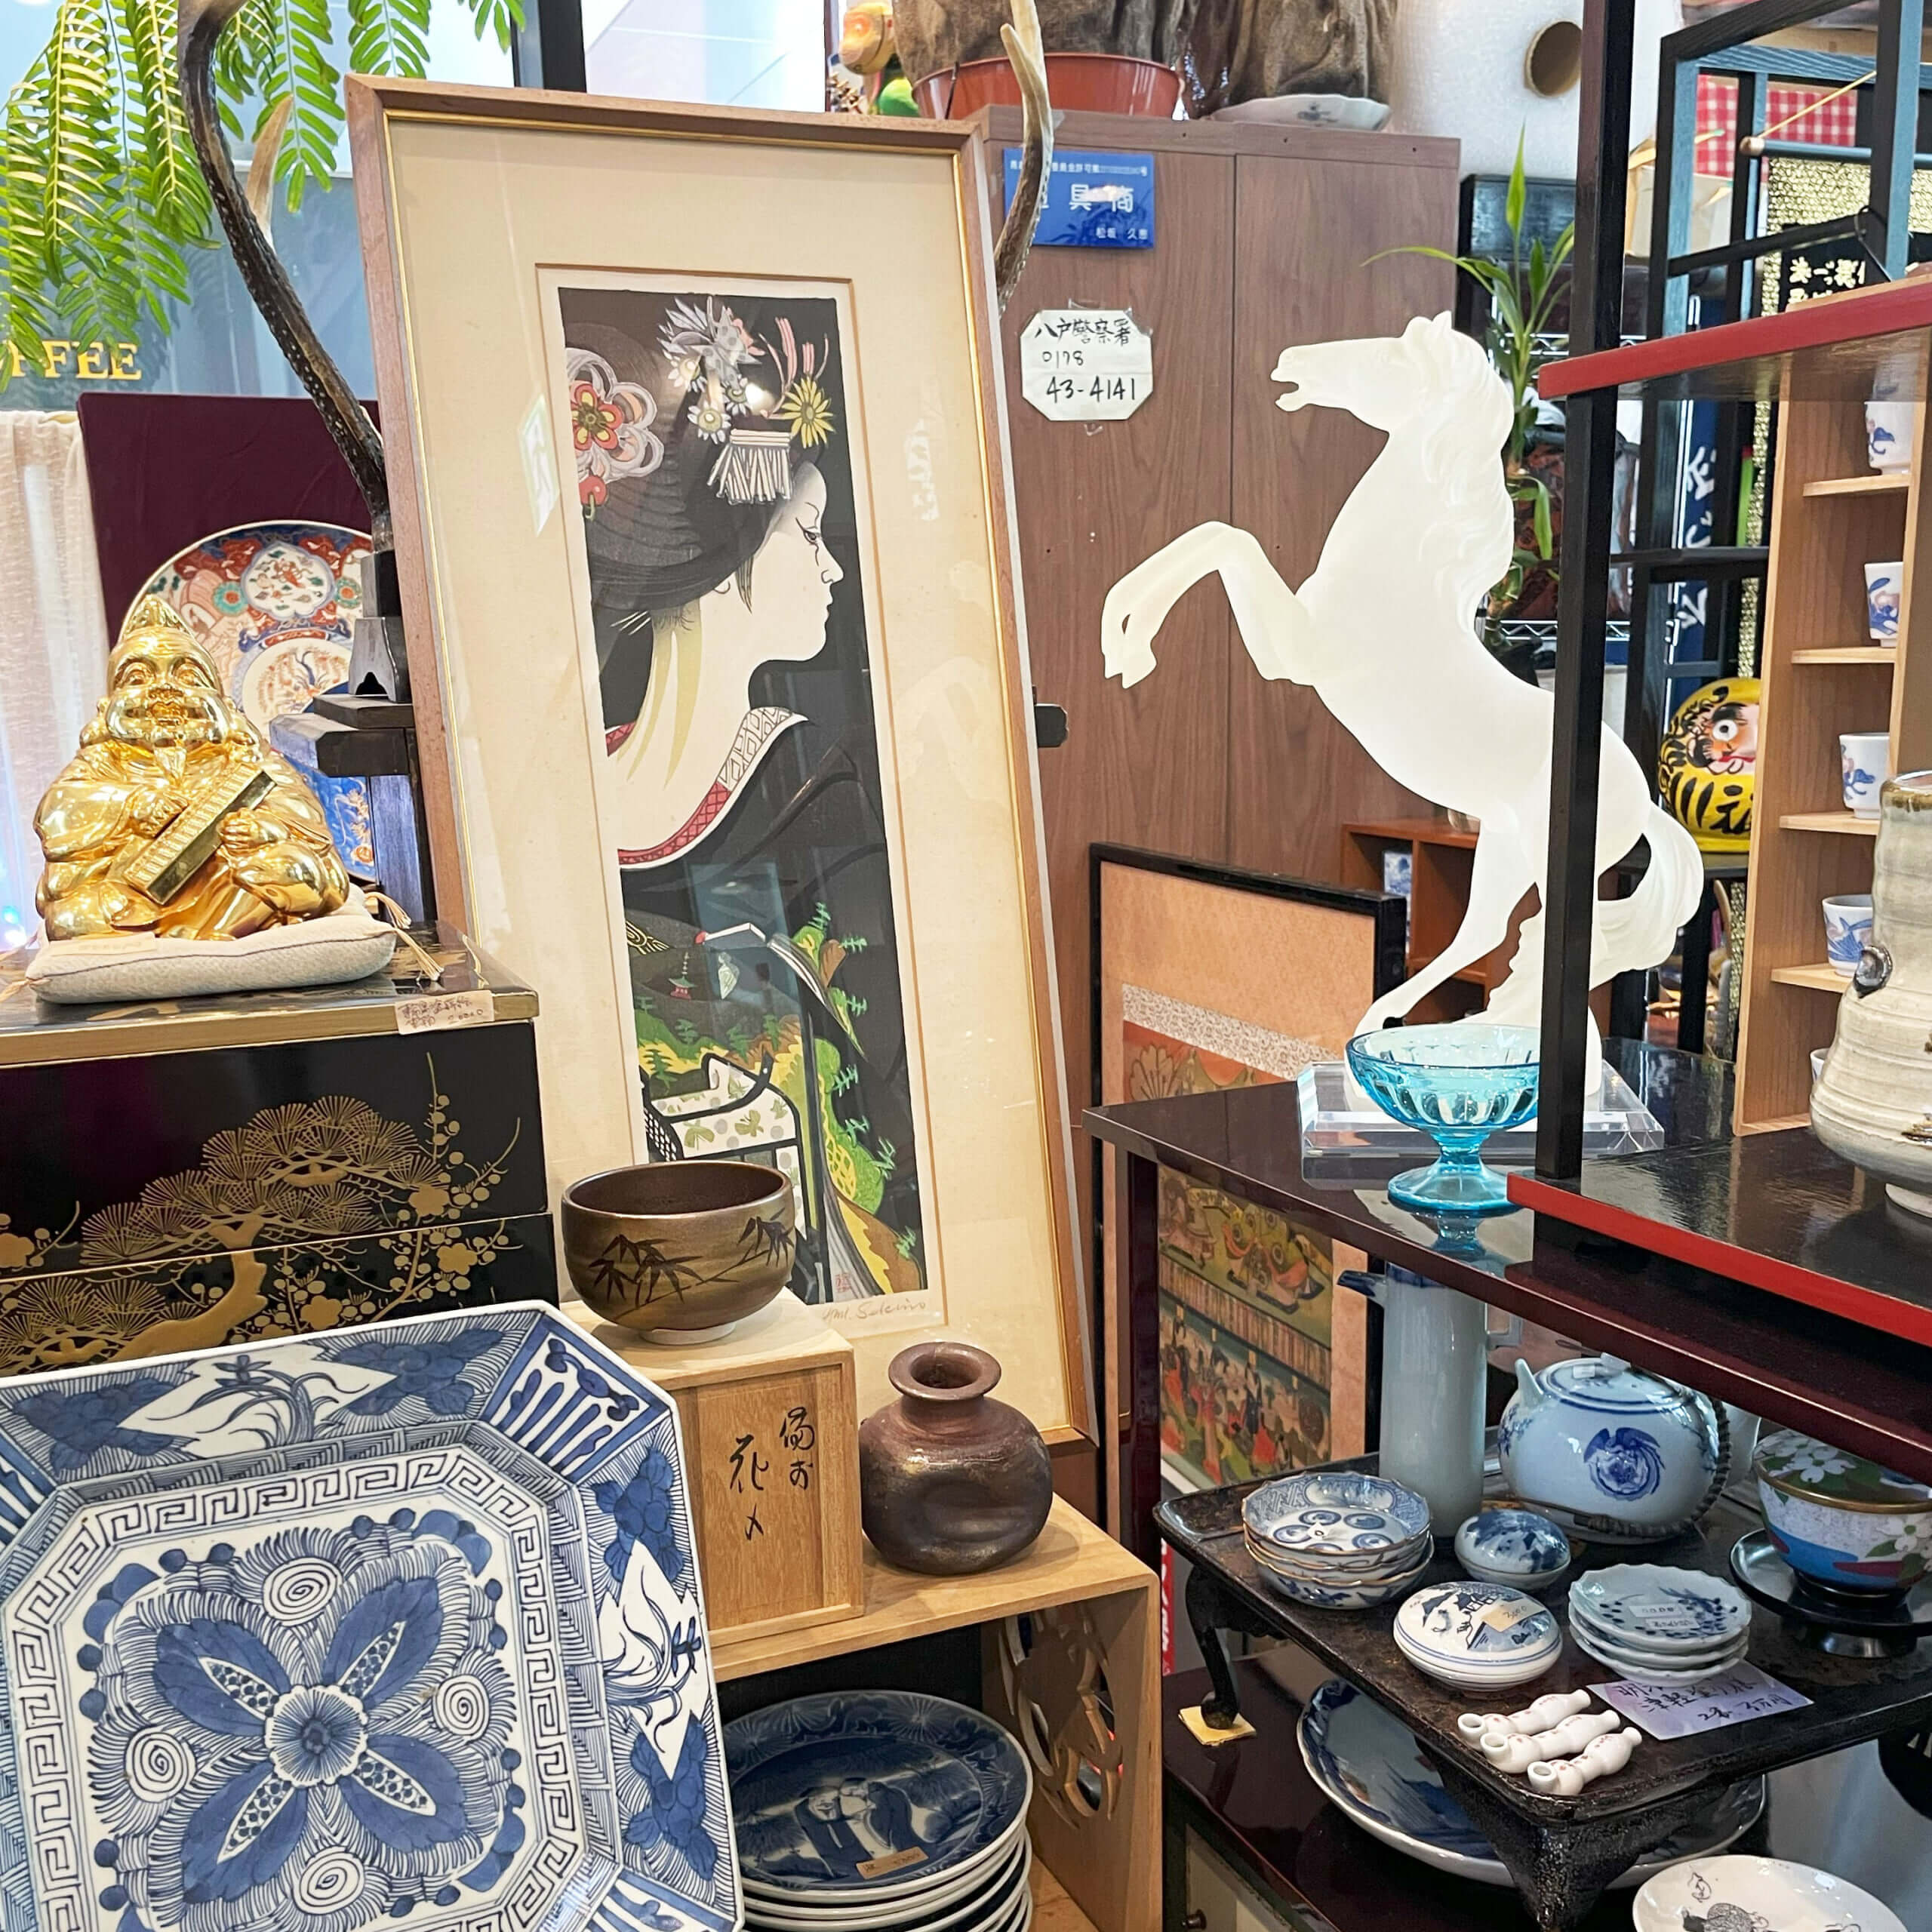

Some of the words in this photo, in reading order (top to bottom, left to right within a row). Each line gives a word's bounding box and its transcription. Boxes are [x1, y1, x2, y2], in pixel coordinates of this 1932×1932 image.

[1040, 183, 1134, 213] 具商
[0, 339, 142, 380] FFEE
[1041, 349, 1084, 369] 0178
[1046, 375, 1135, 404] 43-4141
